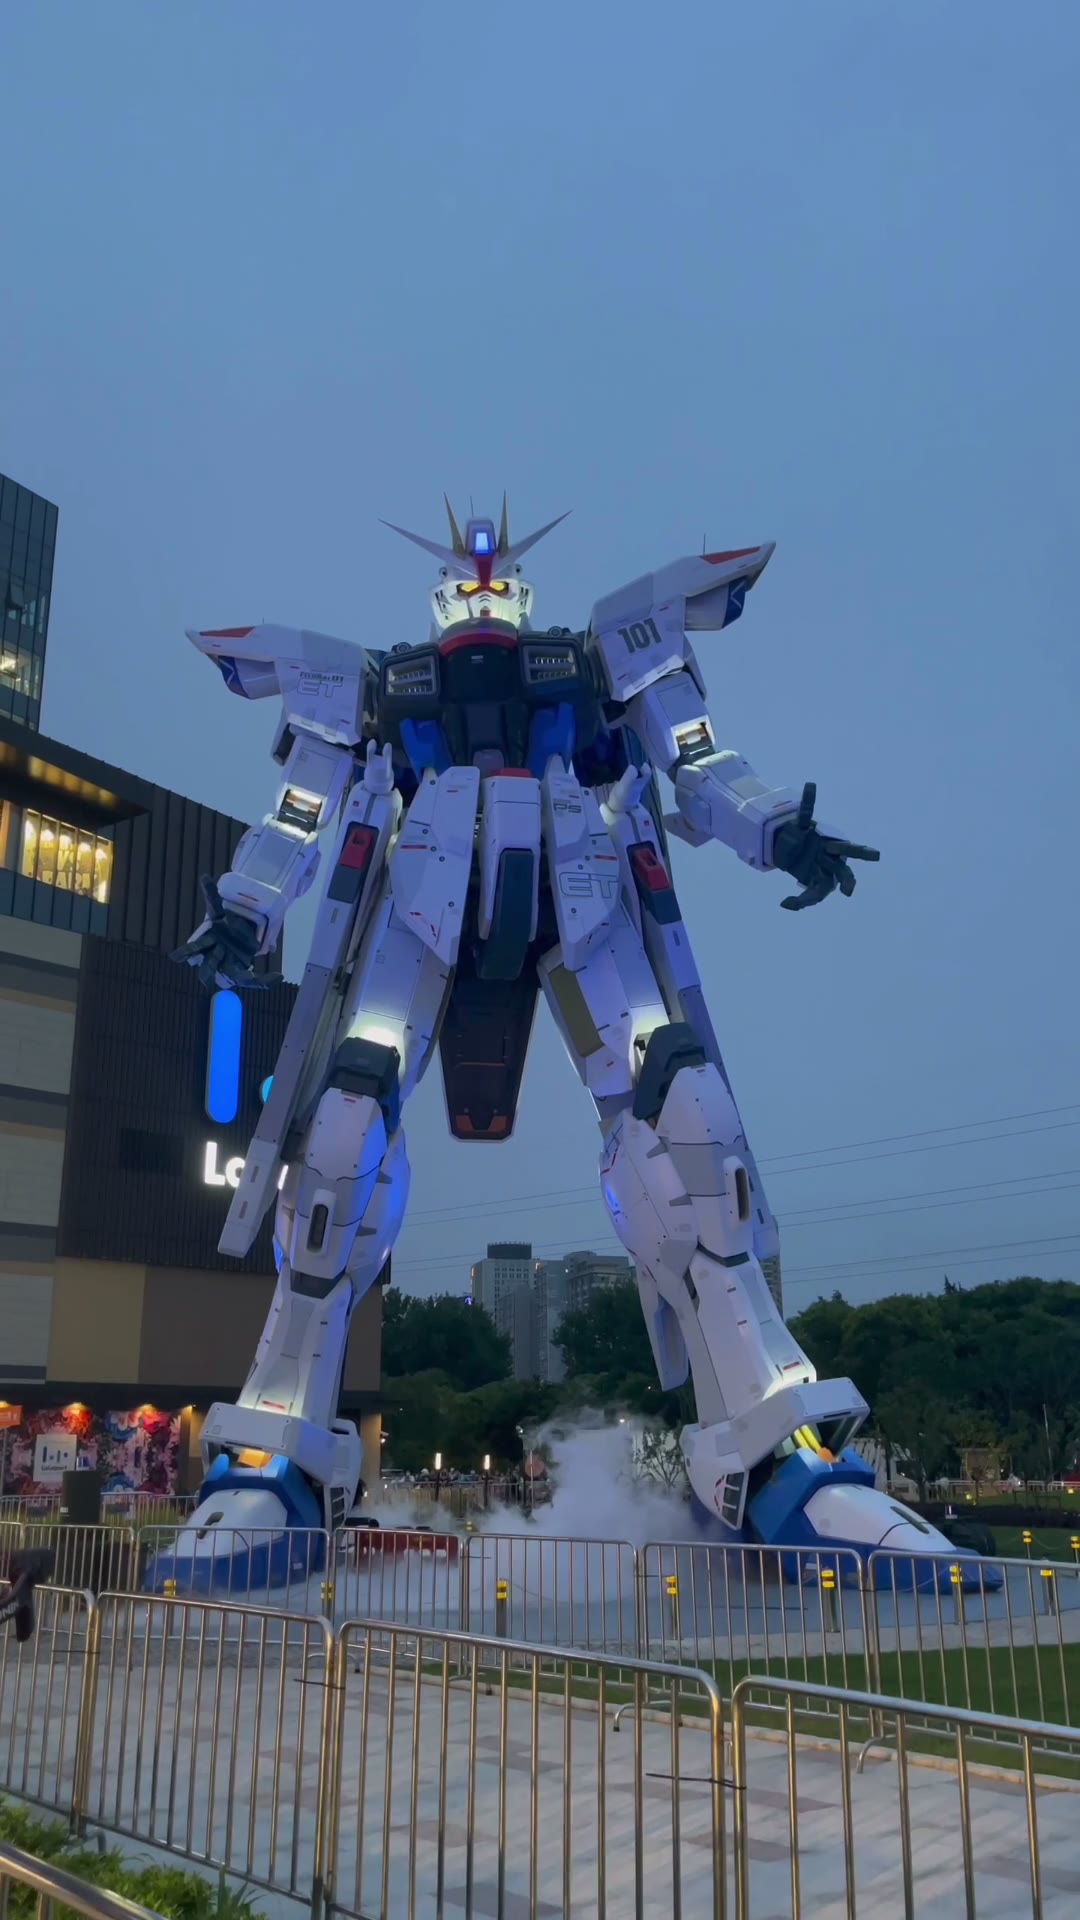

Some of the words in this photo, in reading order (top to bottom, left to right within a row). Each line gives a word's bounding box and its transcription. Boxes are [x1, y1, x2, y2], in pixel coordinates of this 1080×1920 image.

[617, 617, 662, 653] 101
[297, 678, 344, 698] ET
[553, 803, 582, 813] PS
[559, 871, 618, 899] ET
